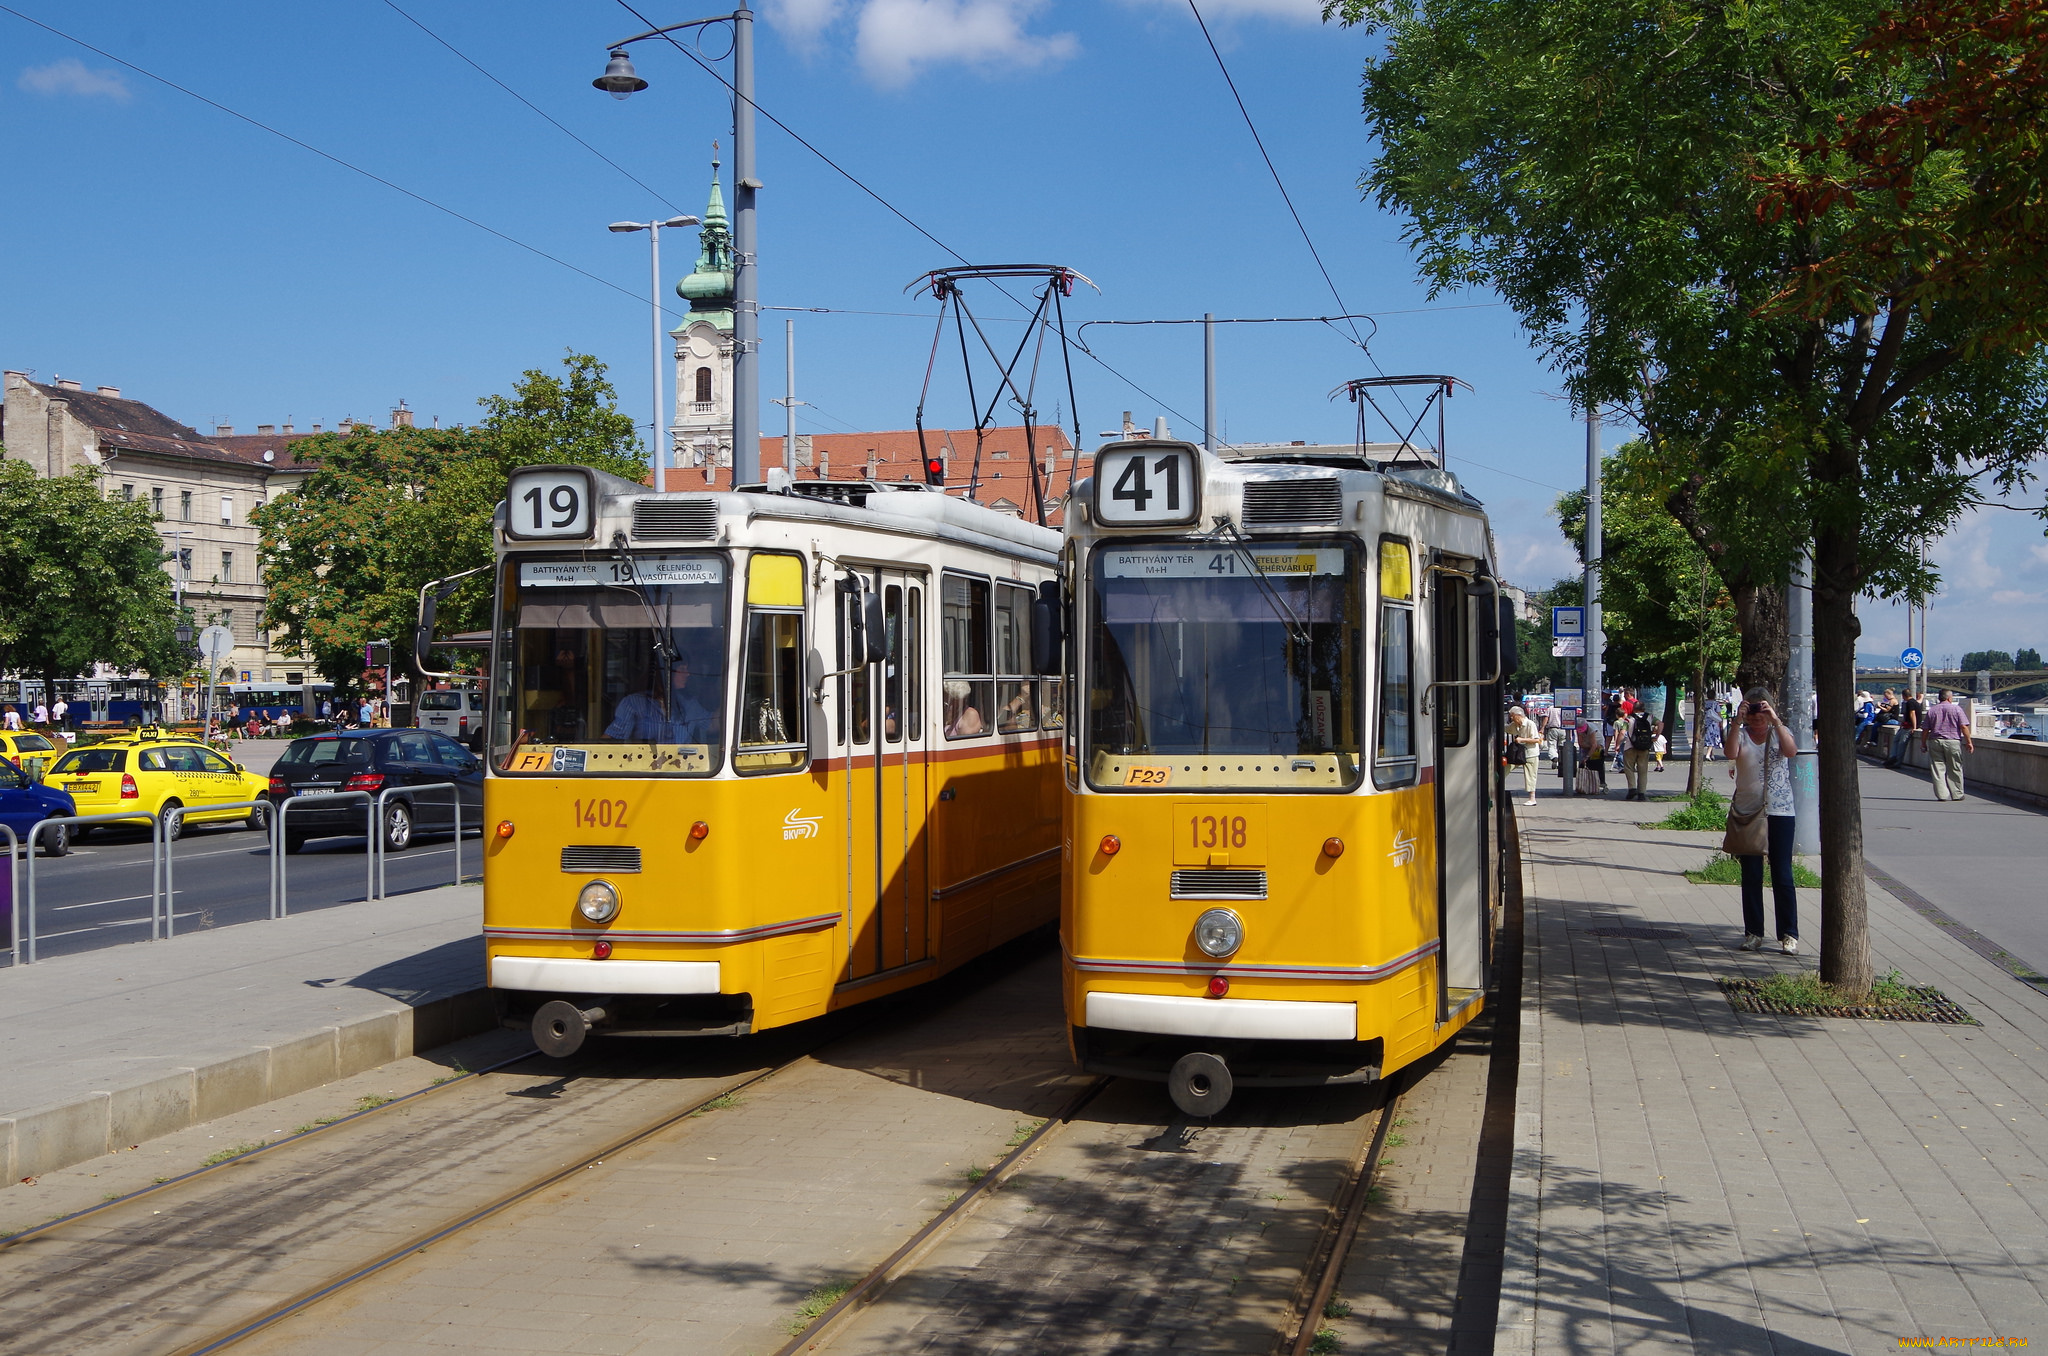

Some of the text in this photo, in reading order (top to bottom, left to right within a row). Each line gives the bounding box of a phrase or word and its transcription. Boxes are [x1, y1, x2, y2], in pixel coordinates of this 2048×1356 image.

[1112, 454, 1180, 512] 41
[522, 484, 580, 529] 19
[1119, 554, 1194, 564] BATTHYÁNY TÉR
[1208, 553, 1235, 574] 41
[1256, 556, 1279, 564] ETELE
[1282, 554, 1293, 564] ÚT
[533, 564, 597, 574] BATTHYÁNY TÉR
[609, 563, 634, 582] 19
[656, 563, 702, 572] KELENFÖLD
[1145, 566, 1167, 574] M+H
[642, 571, 717, 581] VASÚTÁLLOMÁS M
[519, 755, 545, 770] F1
[1129, 769, 1166, 784] F23
[574, 798, 628, 828] 1402
[783, 829, 799, 840] BKV
[1190, 815, 1247, 848] 1318
